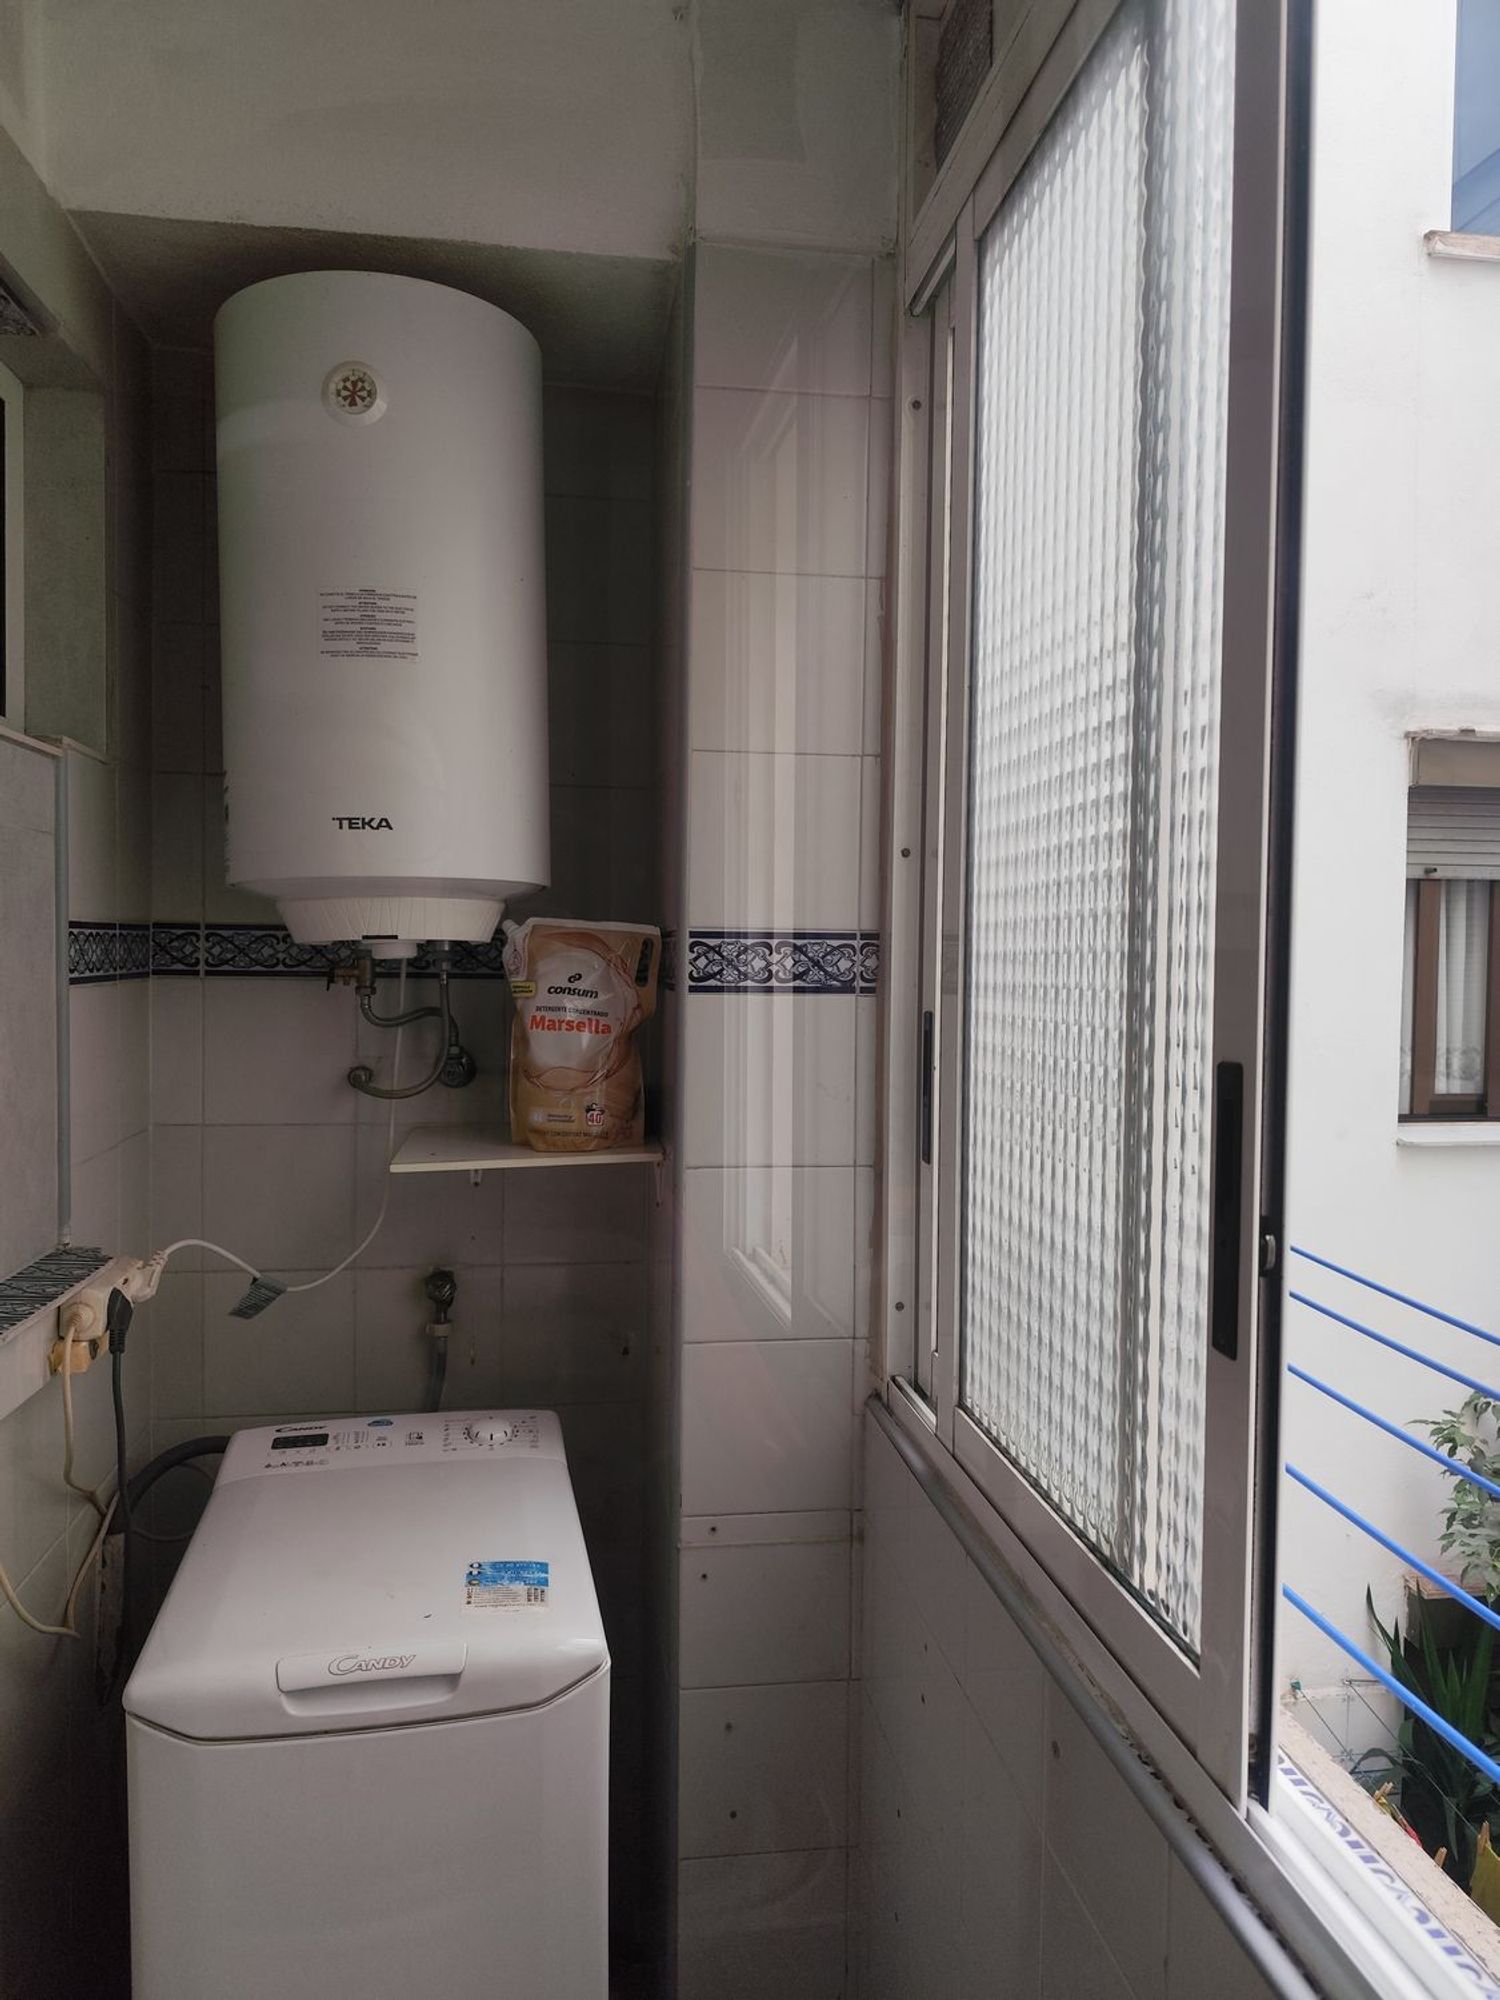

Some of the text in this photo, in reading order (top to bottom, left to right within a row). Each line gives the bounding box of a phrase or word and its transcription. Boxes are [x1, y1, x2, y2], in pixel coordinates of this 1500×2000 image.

[332, 817, 393, 831] TEKA
[547, 985, 599, 999] consum
[529, 1014, 612, 1035] Marsella
[328, 1654, 417, 1676] CANDY
